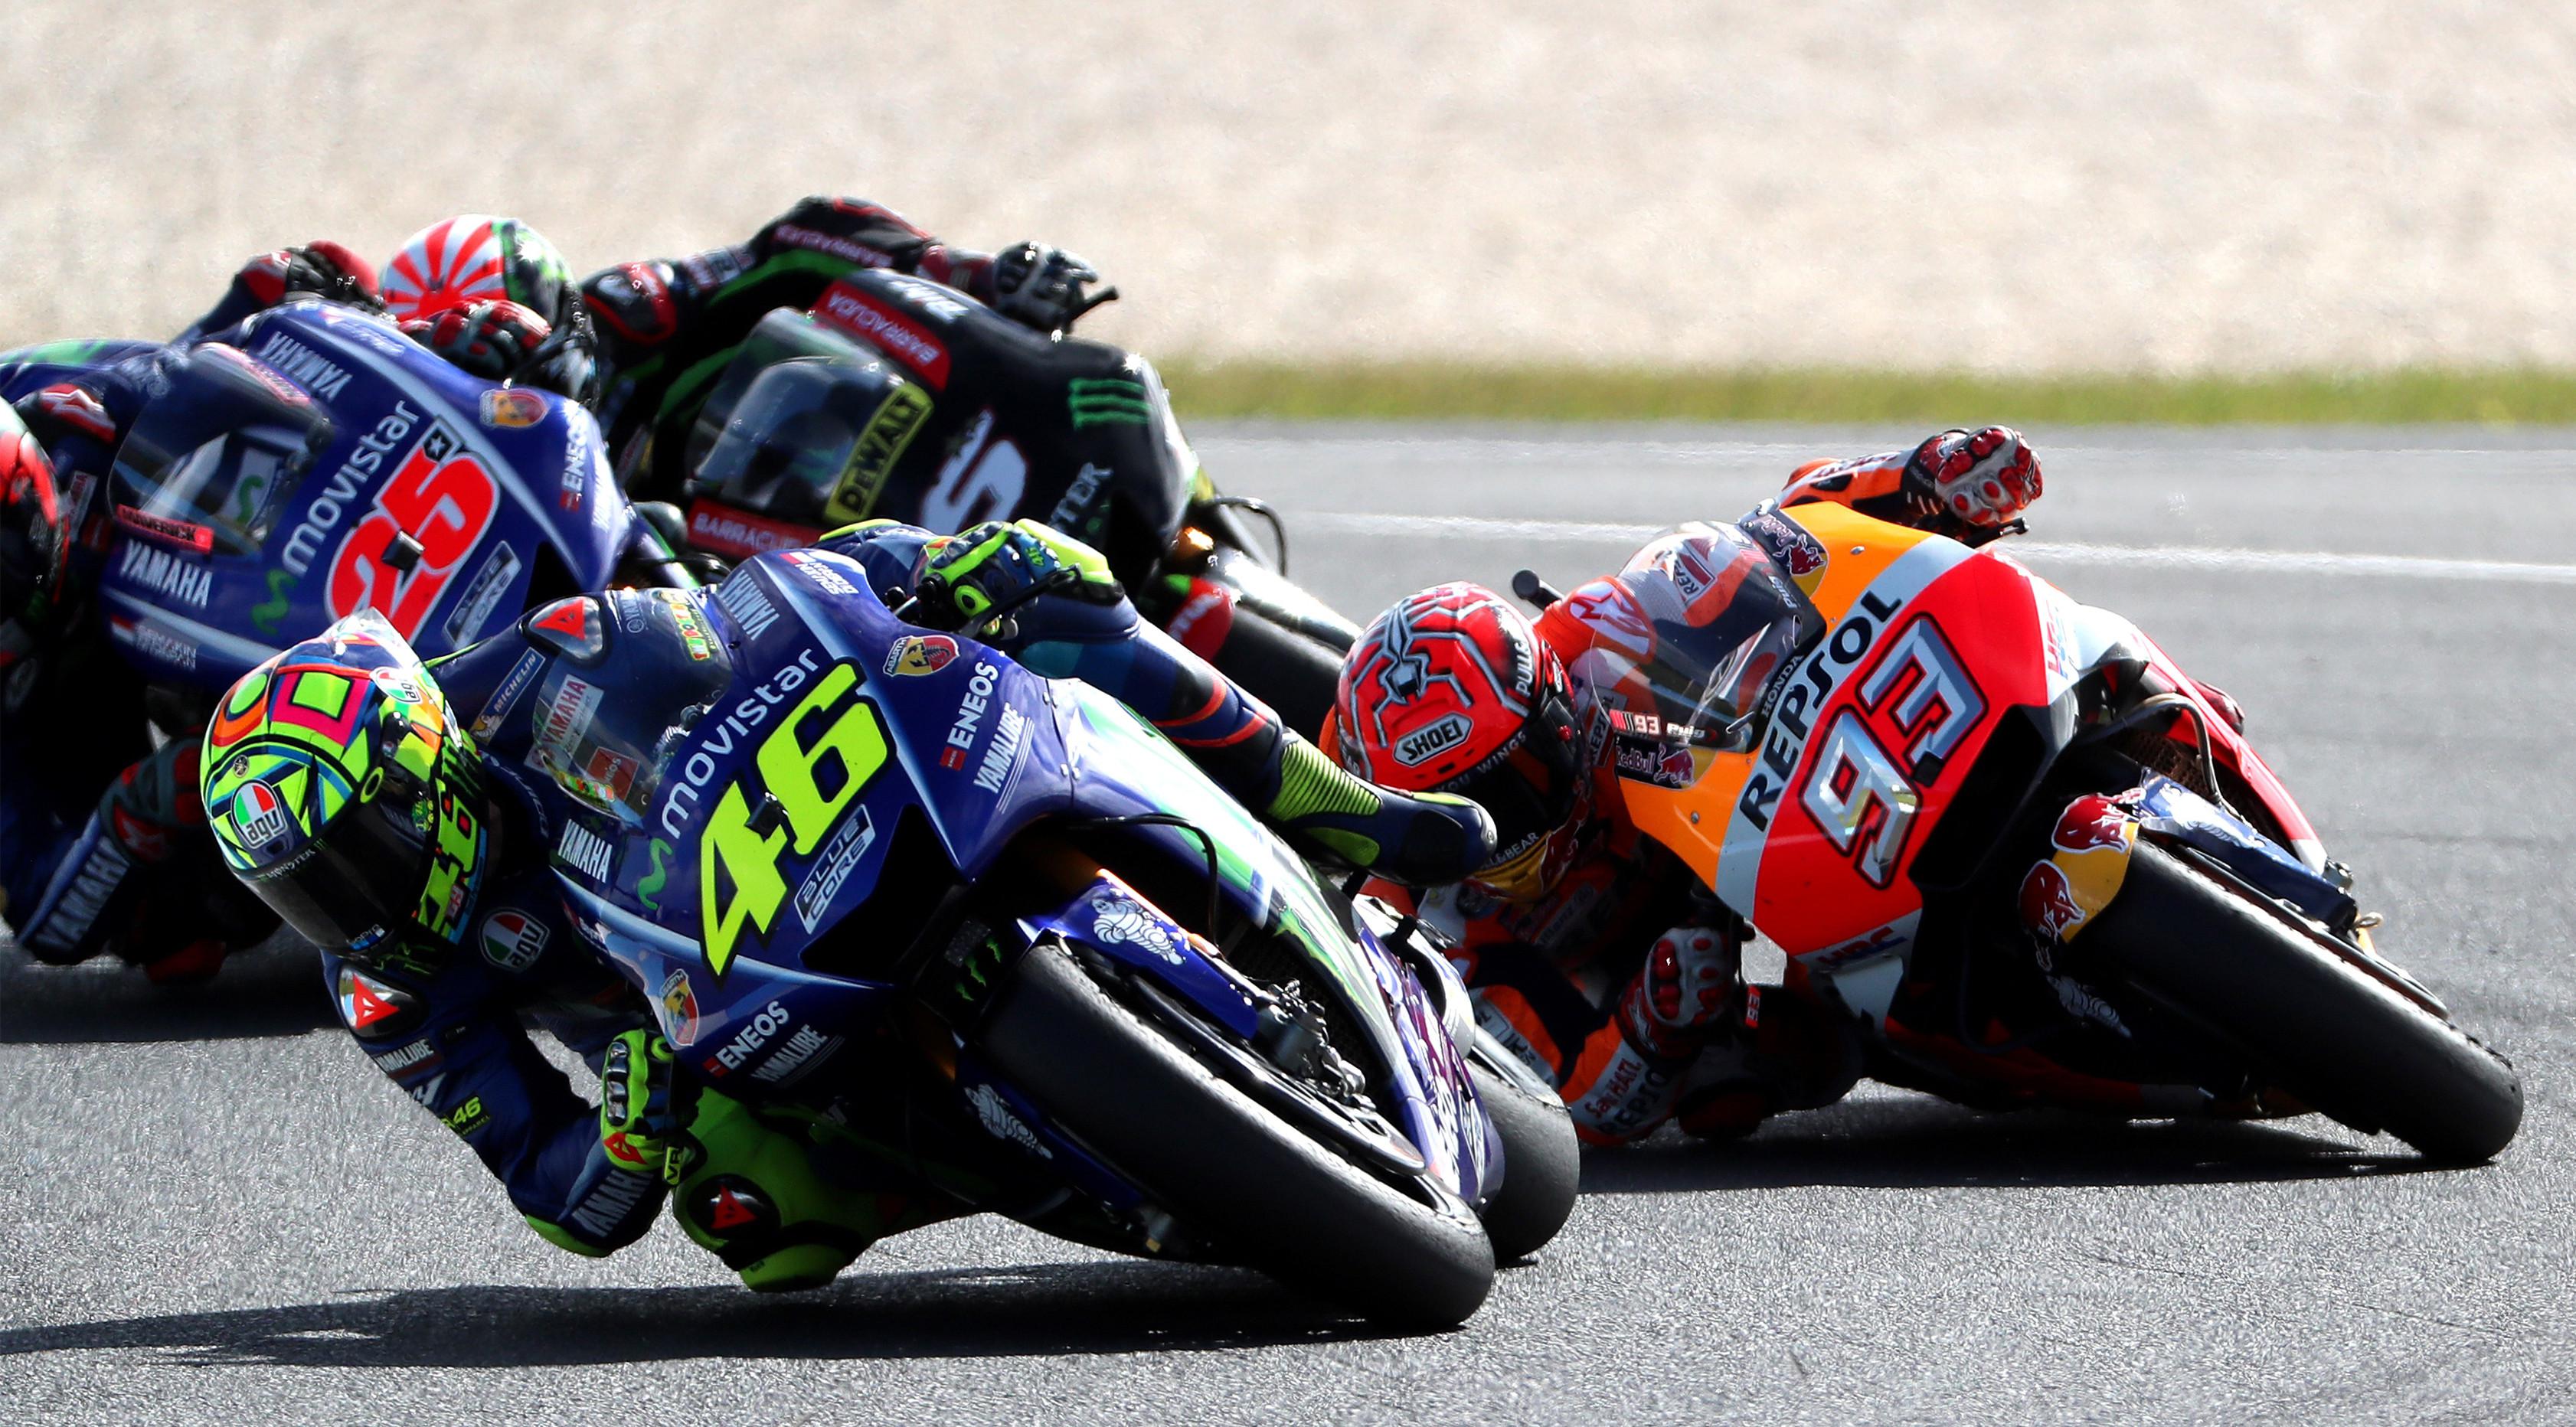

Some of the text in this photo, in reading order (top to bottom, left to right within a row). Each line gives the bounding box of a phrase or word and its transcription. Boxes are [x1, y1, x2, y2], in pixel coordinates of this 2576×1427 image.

[258, 331, 353, 403] YAMAHA
[281, 400, 420, 574] movistar
[838, 392, 918, 514] DEWALT
[324, 416, 502, 648] 25
[120, 537, 213, 609] YAMAHA
[719, 569, 780, 642] YAMAHA
[493, 652, 537, 712] MICHELIN
[885, 638, 907, 673] ABARTH
[1764, 655, 1804, 719] HONDA
[541, 678, 589, 745] YAMAHA
[946, 661, 999, 750] ENEOS
[1402, 718, 1463, 761] SHOEI
[1633, 714, 1661, 735] 93
[1739, 590, 1902, 832] REPSOL
[661, 648, 820, 840] movistar
[973, 701, 1025, 794] YAMALUBE
[1476, 730, 1528, 775] WINGS
[1800, 612, 1989, 889] 93
[245, 808, 281, 842] agv
[557, 818, 613, 883] YAMAHA
[700, 663, 888, 976] 46
[801, 817, 860, 904] BLUE
[809, 834, 867, 921] CORE
[511, 924, 541, 968] agv
[715, 1000, 789, 1069] ENEOS
[750, 1024, 829, 1082] YAMALUBE
